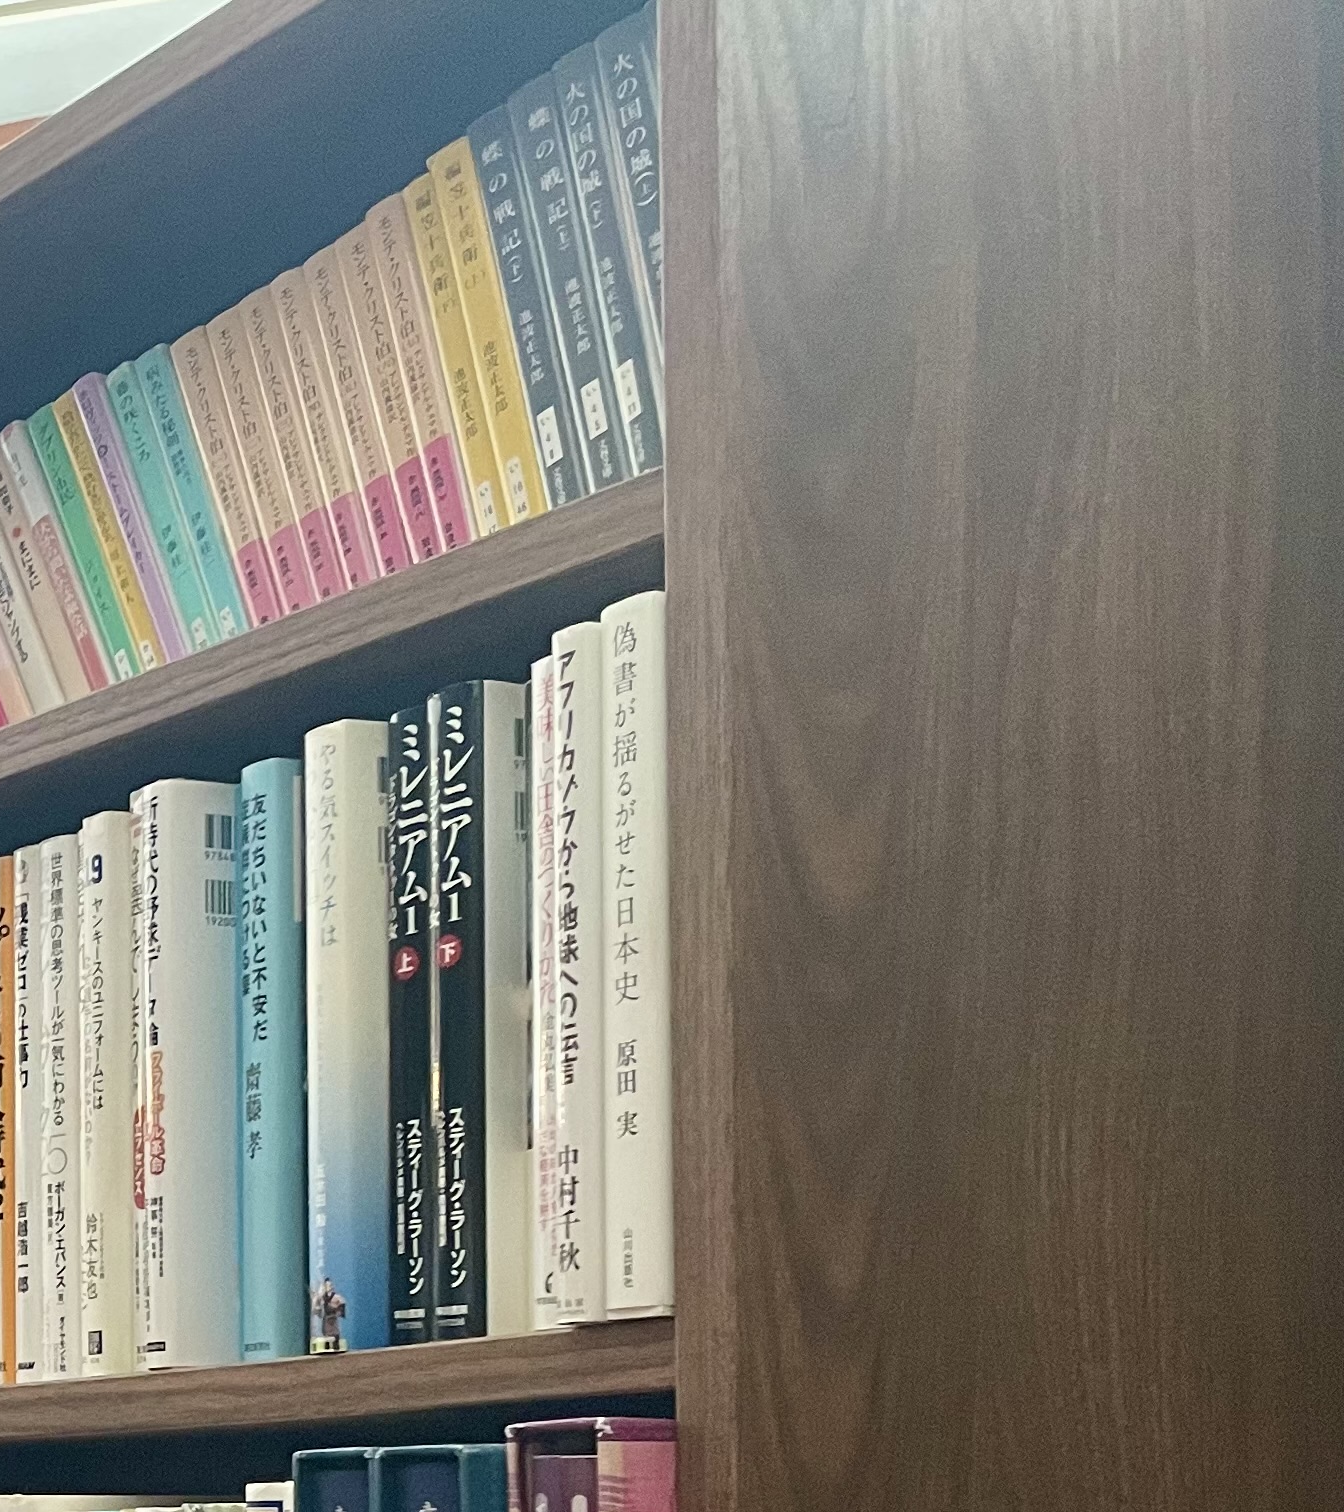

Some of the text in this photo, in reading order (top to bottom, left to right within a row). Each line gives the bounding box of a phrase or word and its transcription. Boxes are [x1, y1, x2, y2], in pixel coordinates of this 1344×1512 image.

[51, 851, 66, 1127] 世界標準の思考ツールが一気にわかる
[251, 794, 268, 1042] 友だちいないと不安だ
[396, 723, 430, 1296] ミレニアム1 上 スティーグ・ラーソン
[439, 705, 475, 1289] ミレニアム1 下 スティーグ・ラーソン
[612, 621, 640, 1140] 偽書が揺るがせた日本史 原田 実
[85, 897, 105, 1300] ヤンキースのユニフォームには 鈴木友也
[557, 1144, 581, 1273] 中村千秋
